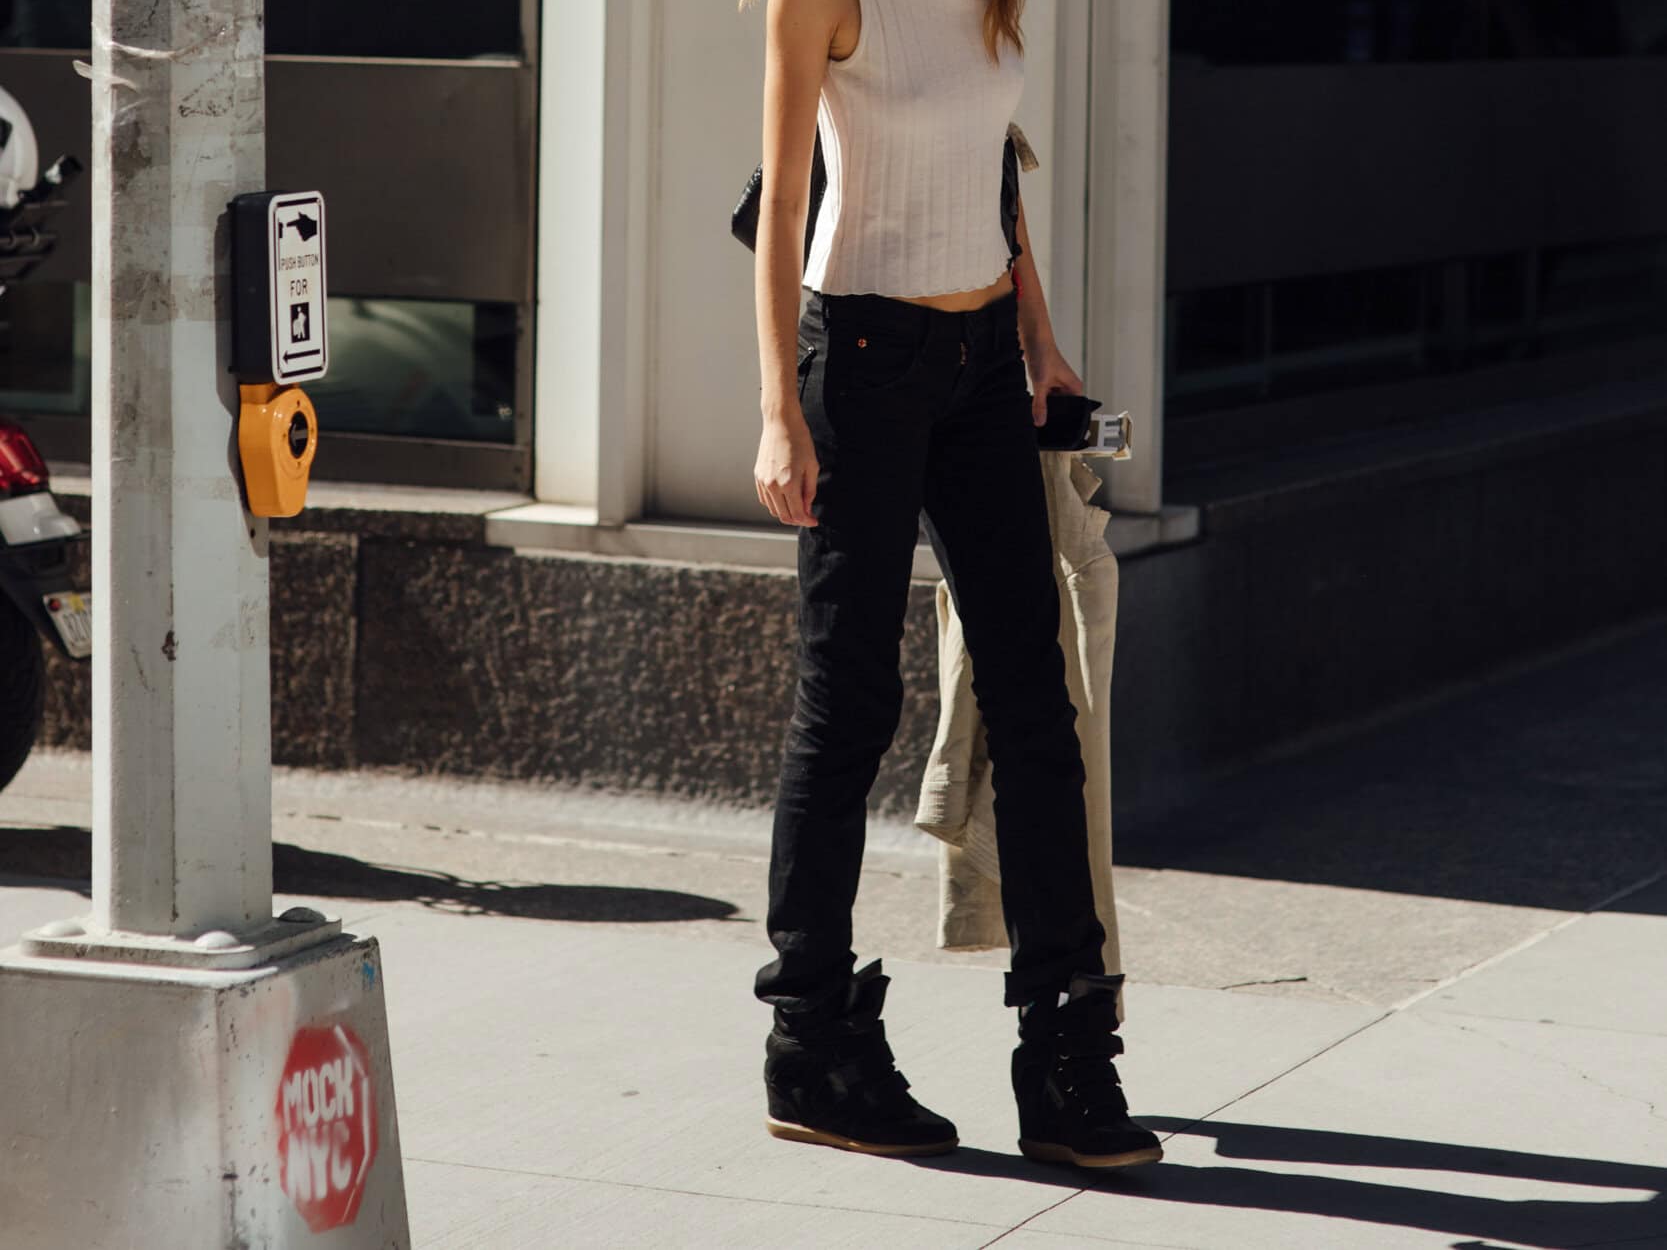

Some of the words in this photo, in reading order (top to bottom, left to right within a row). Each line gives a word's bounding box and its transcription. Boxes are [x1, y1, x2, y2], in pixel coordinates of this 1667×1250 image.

[280, 256, 297, 270] PUSH
[298, 253, 319, 268] BUTTON
[290, 278, 308, 297] FOR
[284, 1056, 353, 1130] MOCK
[287, 1127, 352, 1201] NYC
